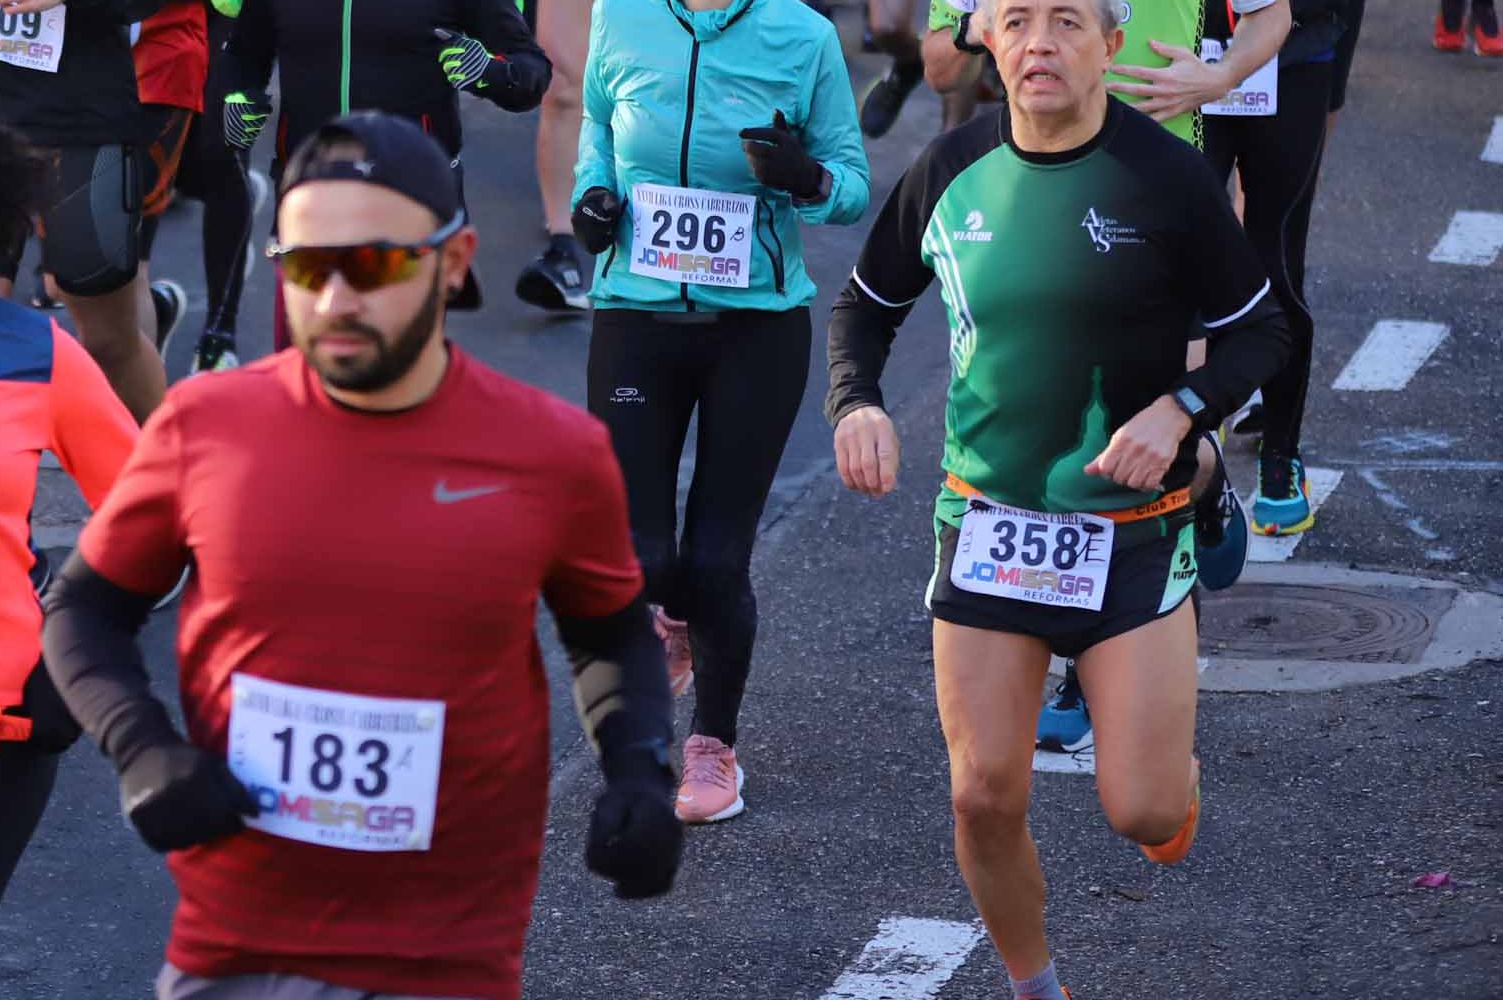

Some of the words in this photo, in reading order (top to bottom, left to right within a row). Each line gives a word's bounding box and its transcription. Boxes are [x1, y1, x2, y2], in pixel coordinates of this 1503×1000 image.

[651, 210, 726, 254] 296
[953, 231, 993, 242] VIATOR
[637, 247, 741, 277] JOMISAGA
[682, 273, 738, 286] REFORMAS
[1135, 500, 1167, 516] Club
[990, 520, 1080, 571] 358
[962, 561, 1094, 597] JOMISAGA
[1024, 590, 1090, 606] REFORMAS
[273, 726, 391, 799] 183
